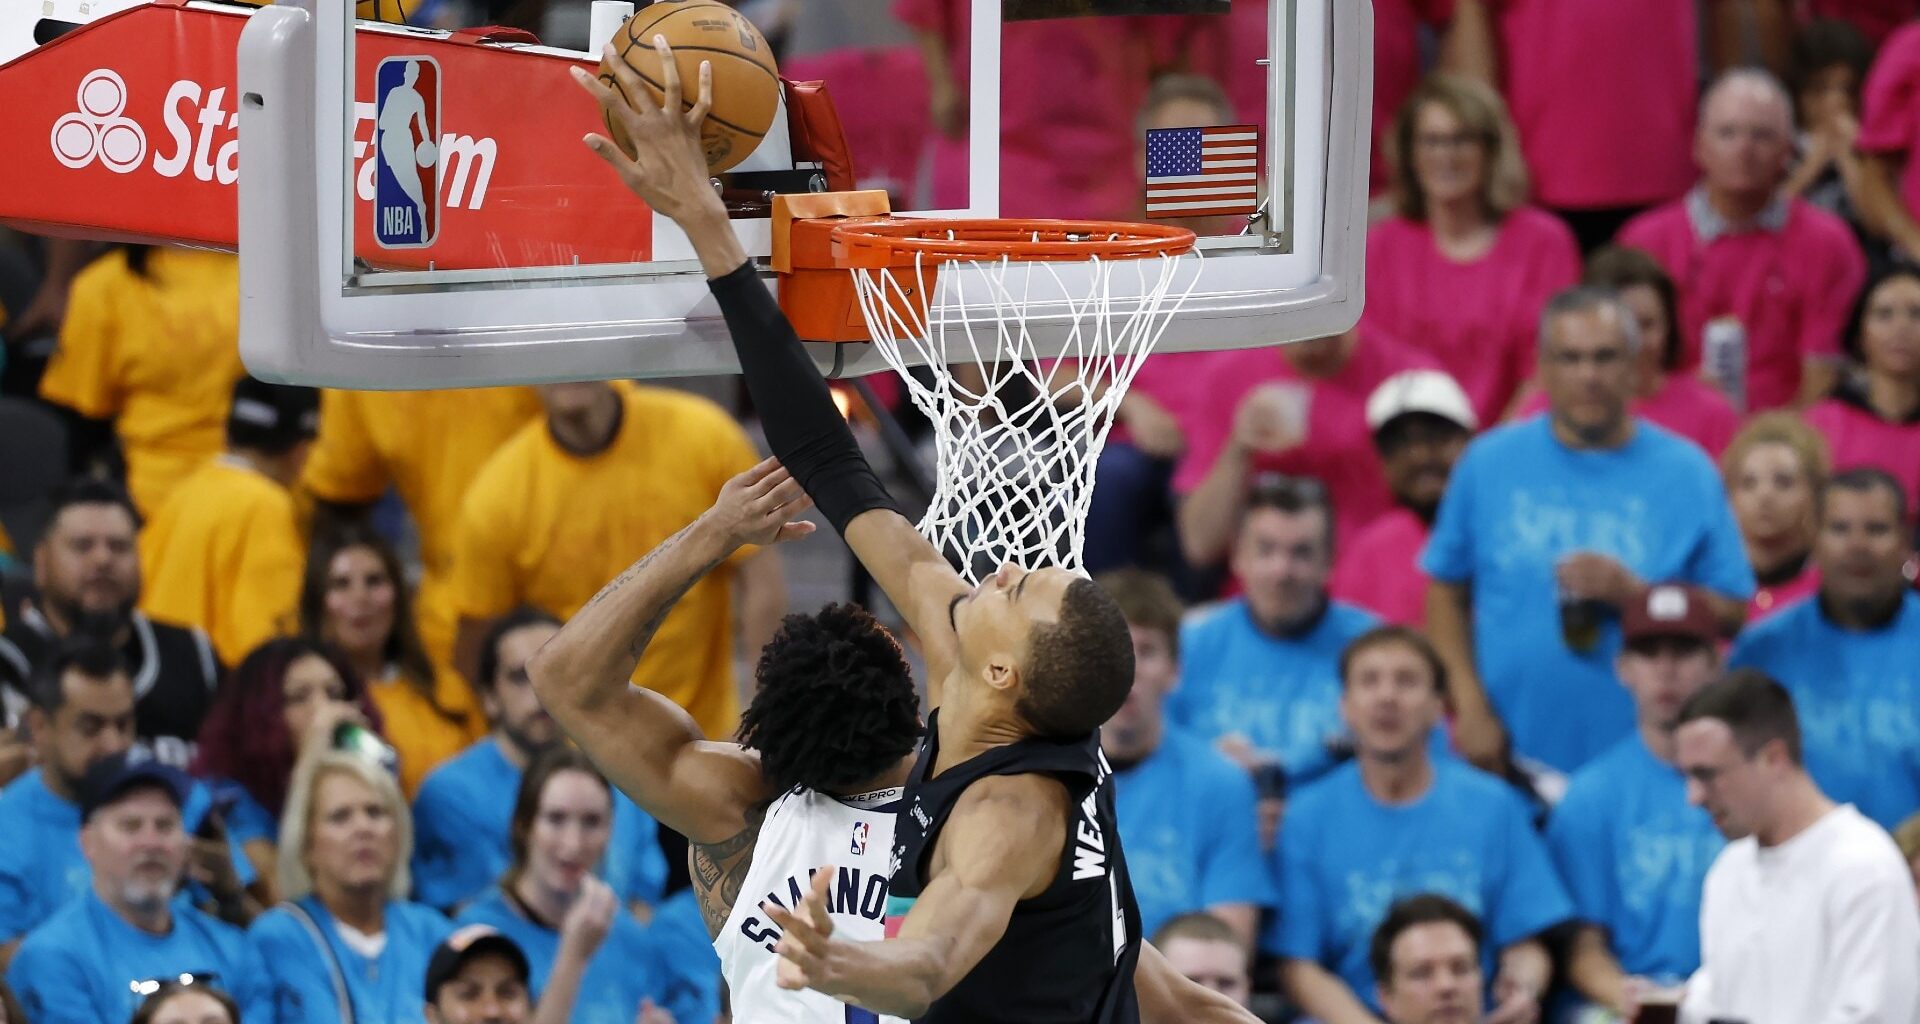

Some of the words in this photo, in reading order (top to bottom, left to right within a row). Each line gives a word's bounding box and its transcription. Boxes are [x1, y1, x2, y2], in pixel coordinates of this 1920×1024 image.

[153, 80, 239, 185] Sta
[383, 206, 413, 236] NBA
[868, 789, 896, 801] PRO
